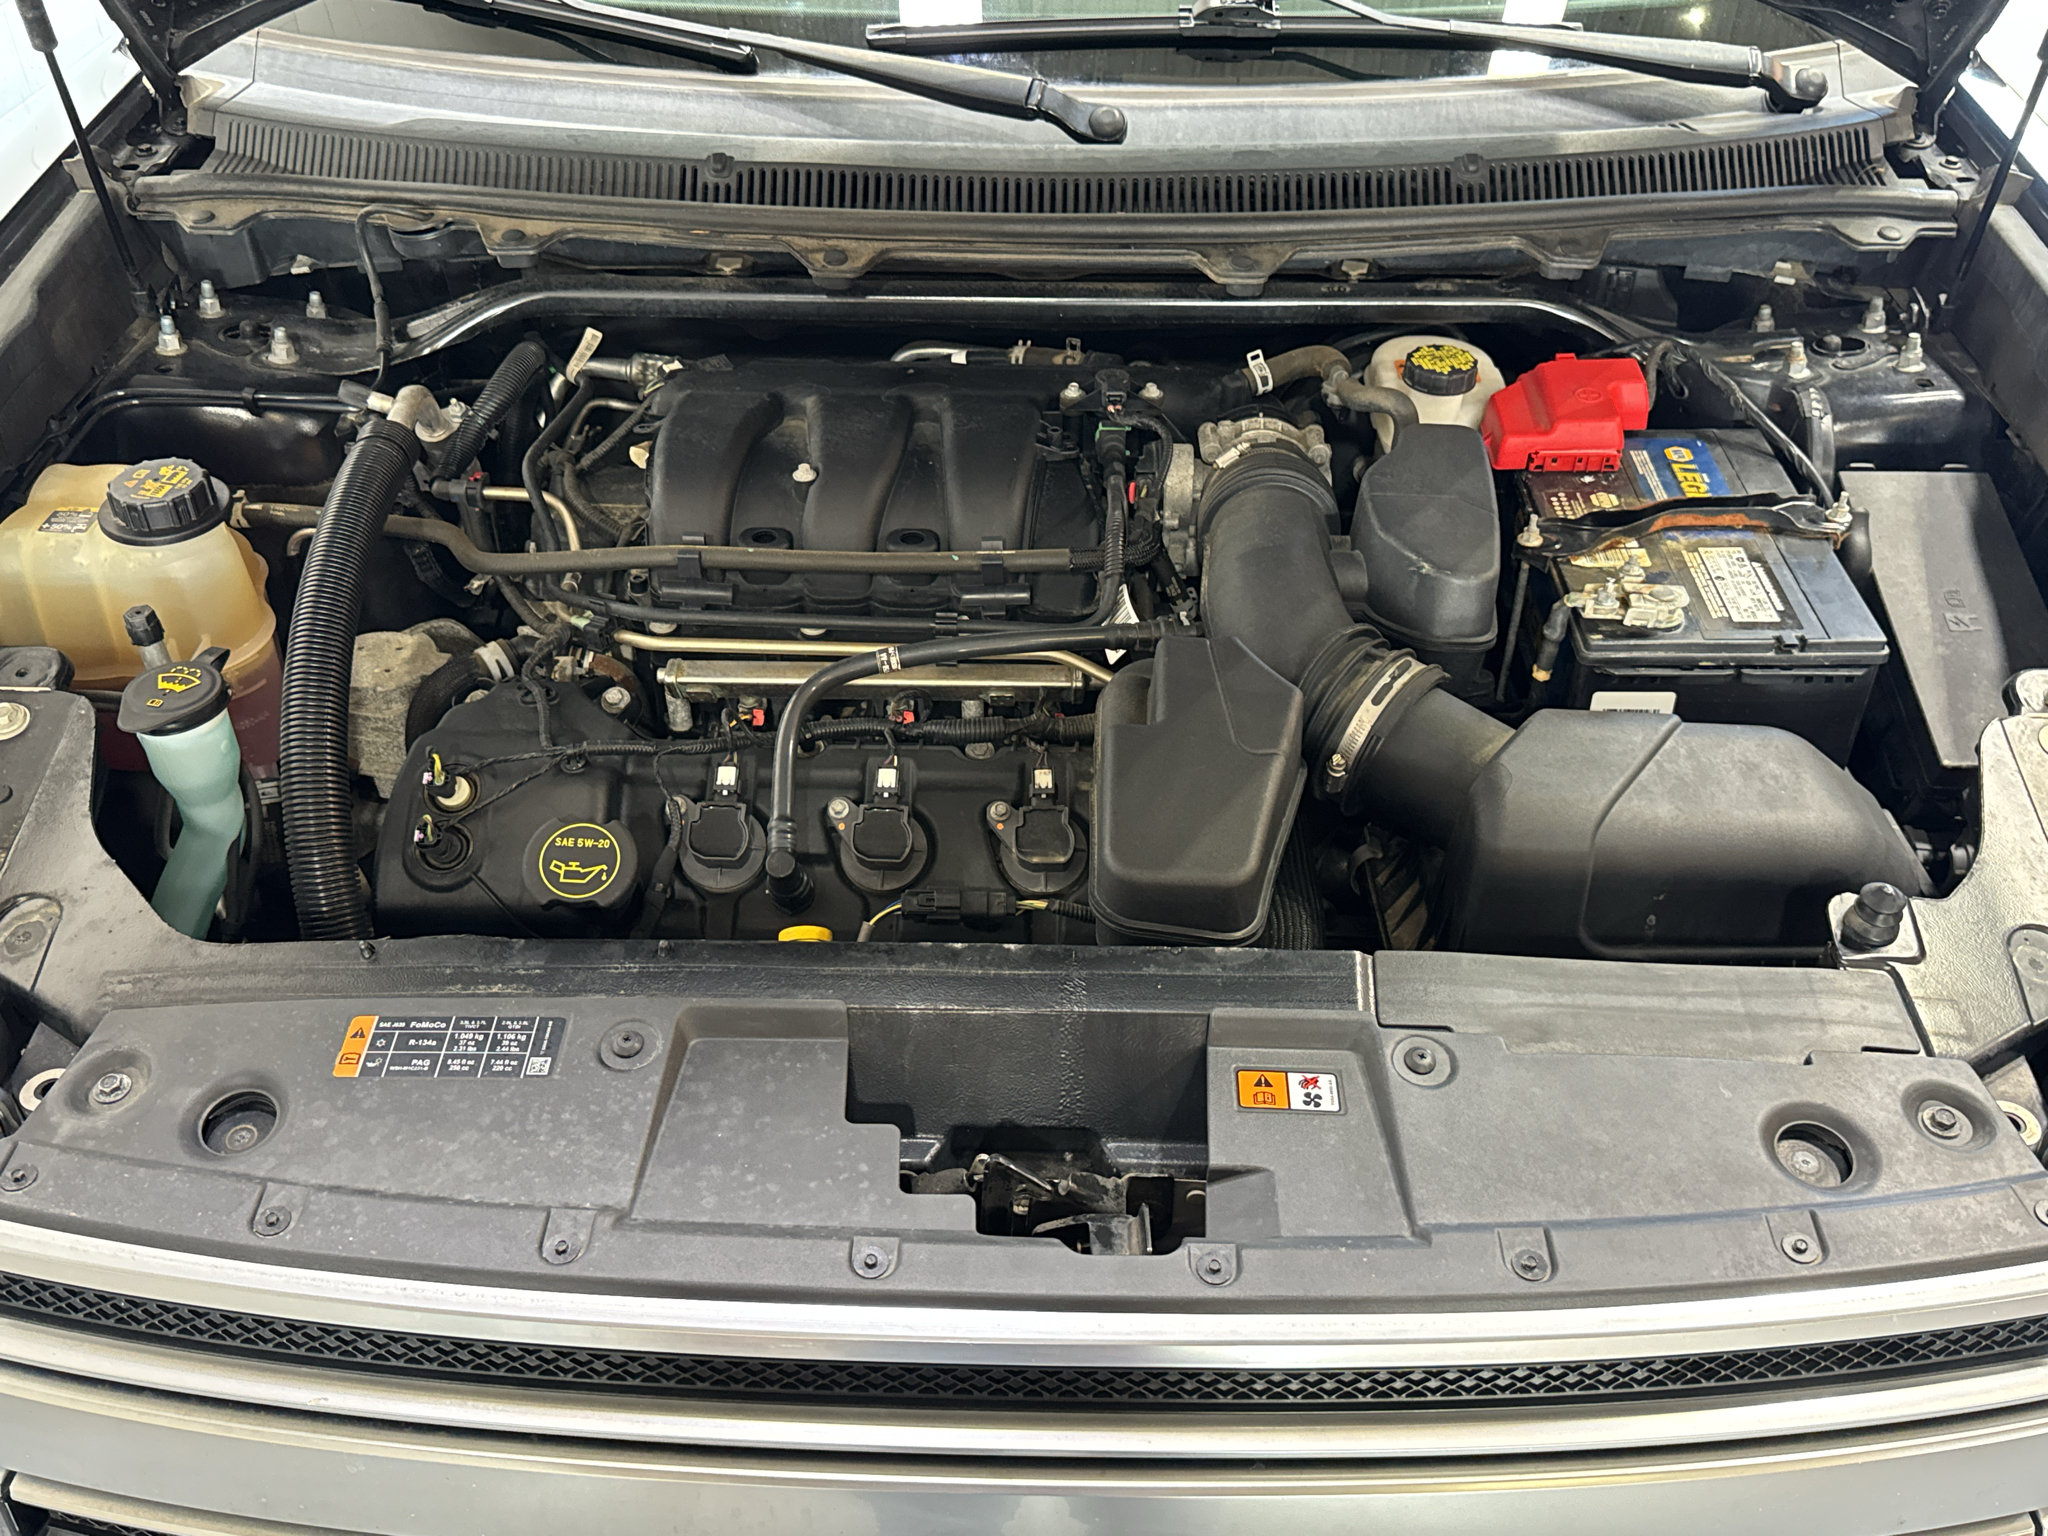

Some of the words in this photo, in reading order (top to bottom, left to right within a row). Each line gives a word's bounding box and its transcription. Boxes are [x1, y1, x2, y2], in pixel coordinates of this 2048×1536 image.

[554, 837, 575, 847] SAE
[577, 838, 610, 849] 5W-20
[474, 1033, 484, 1041] kg
[517, 1033, 527, 1041] kg
